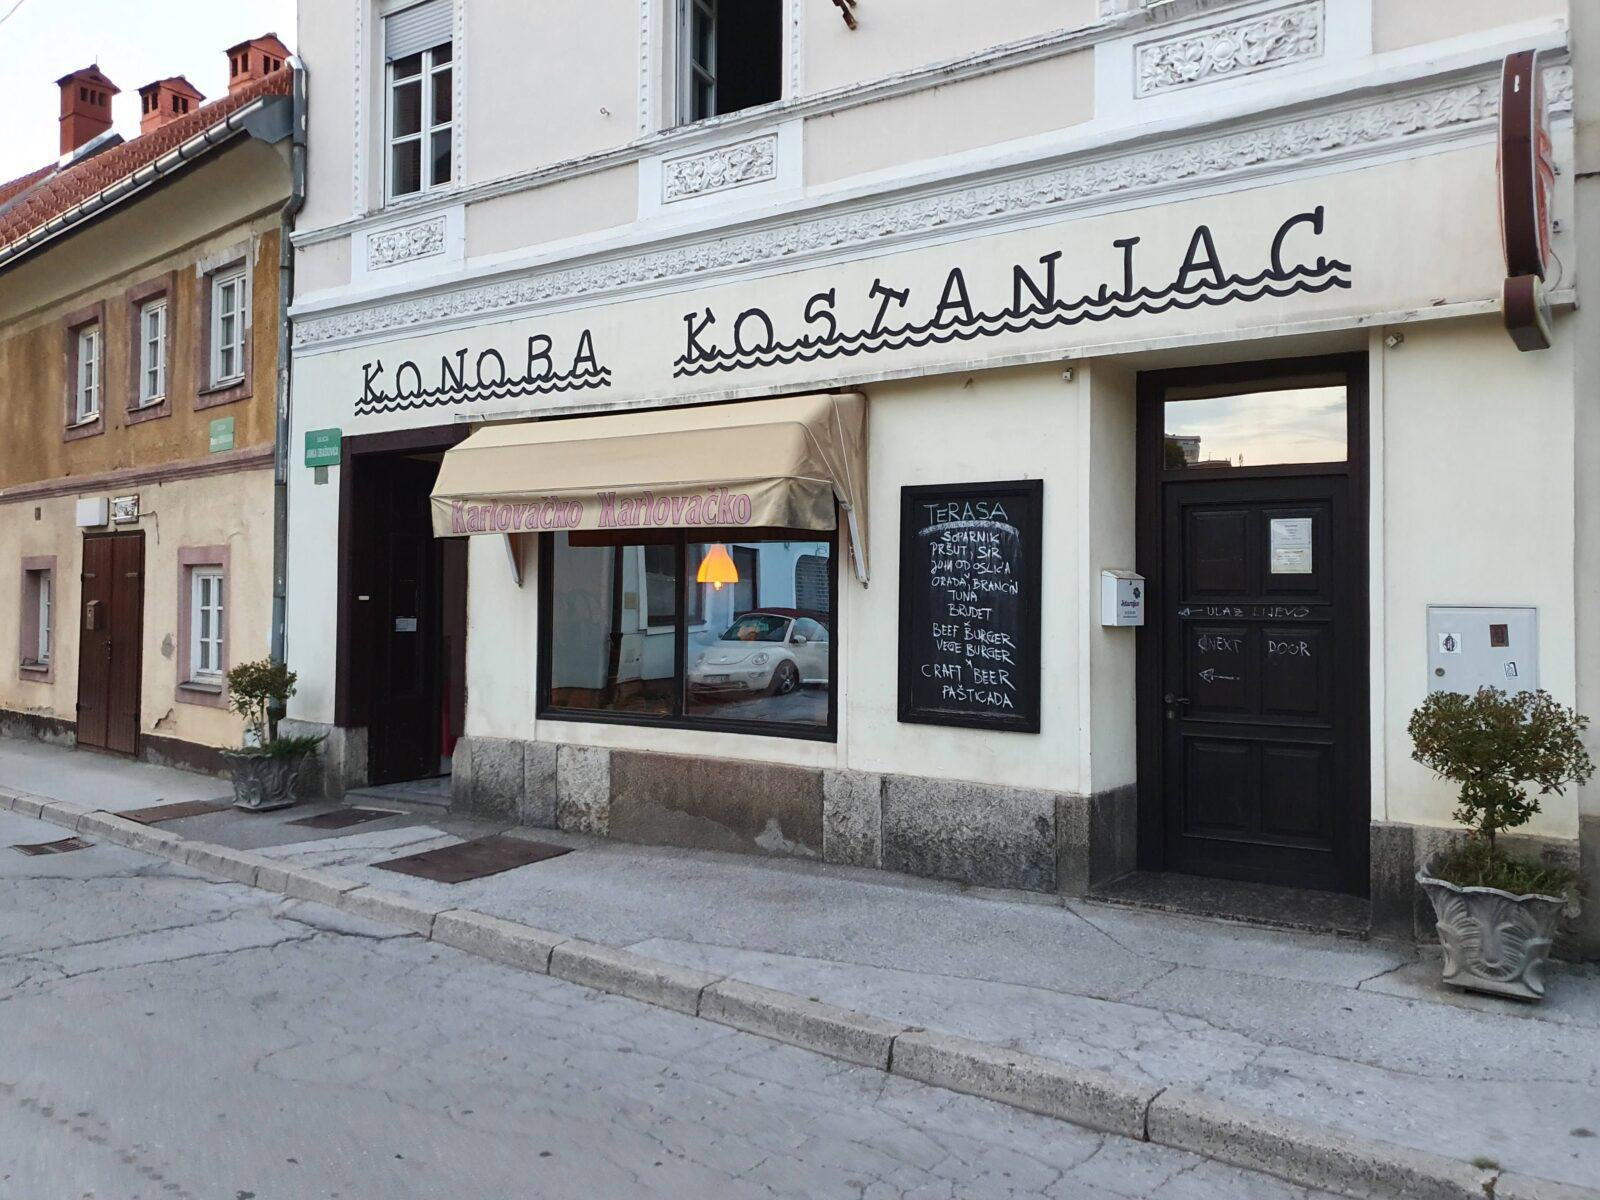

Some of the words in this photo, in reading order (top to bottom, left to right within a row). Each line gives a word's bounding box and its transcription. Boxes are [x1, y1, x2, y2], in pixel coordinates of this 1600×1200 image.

[359, 329, 604, 405] KONOBA
[680, 205, 1340, 365] KOSTANJAC
[451, 496, 584, 533] Karlovačko
[597, 487, 752, 527] Karlovačko
[923, 501, 1008, 525] TERASA
[955, 560, 971, 570] OD
[948, 590, 977, 602] TUNA
[948, 604, 992, 621] BRUDET
[933, 622, 959, 638] BEEF
[964, 627, 1016, 649] BURGER
[1269, 640, 1311, 656] DOOR
[936, 639, 962, 653] VEGE
[966, 644, 1015, 666] BURGER
[921, 664, 962, 681] CRAFT
[973, 668, 1016, 691] BEER
